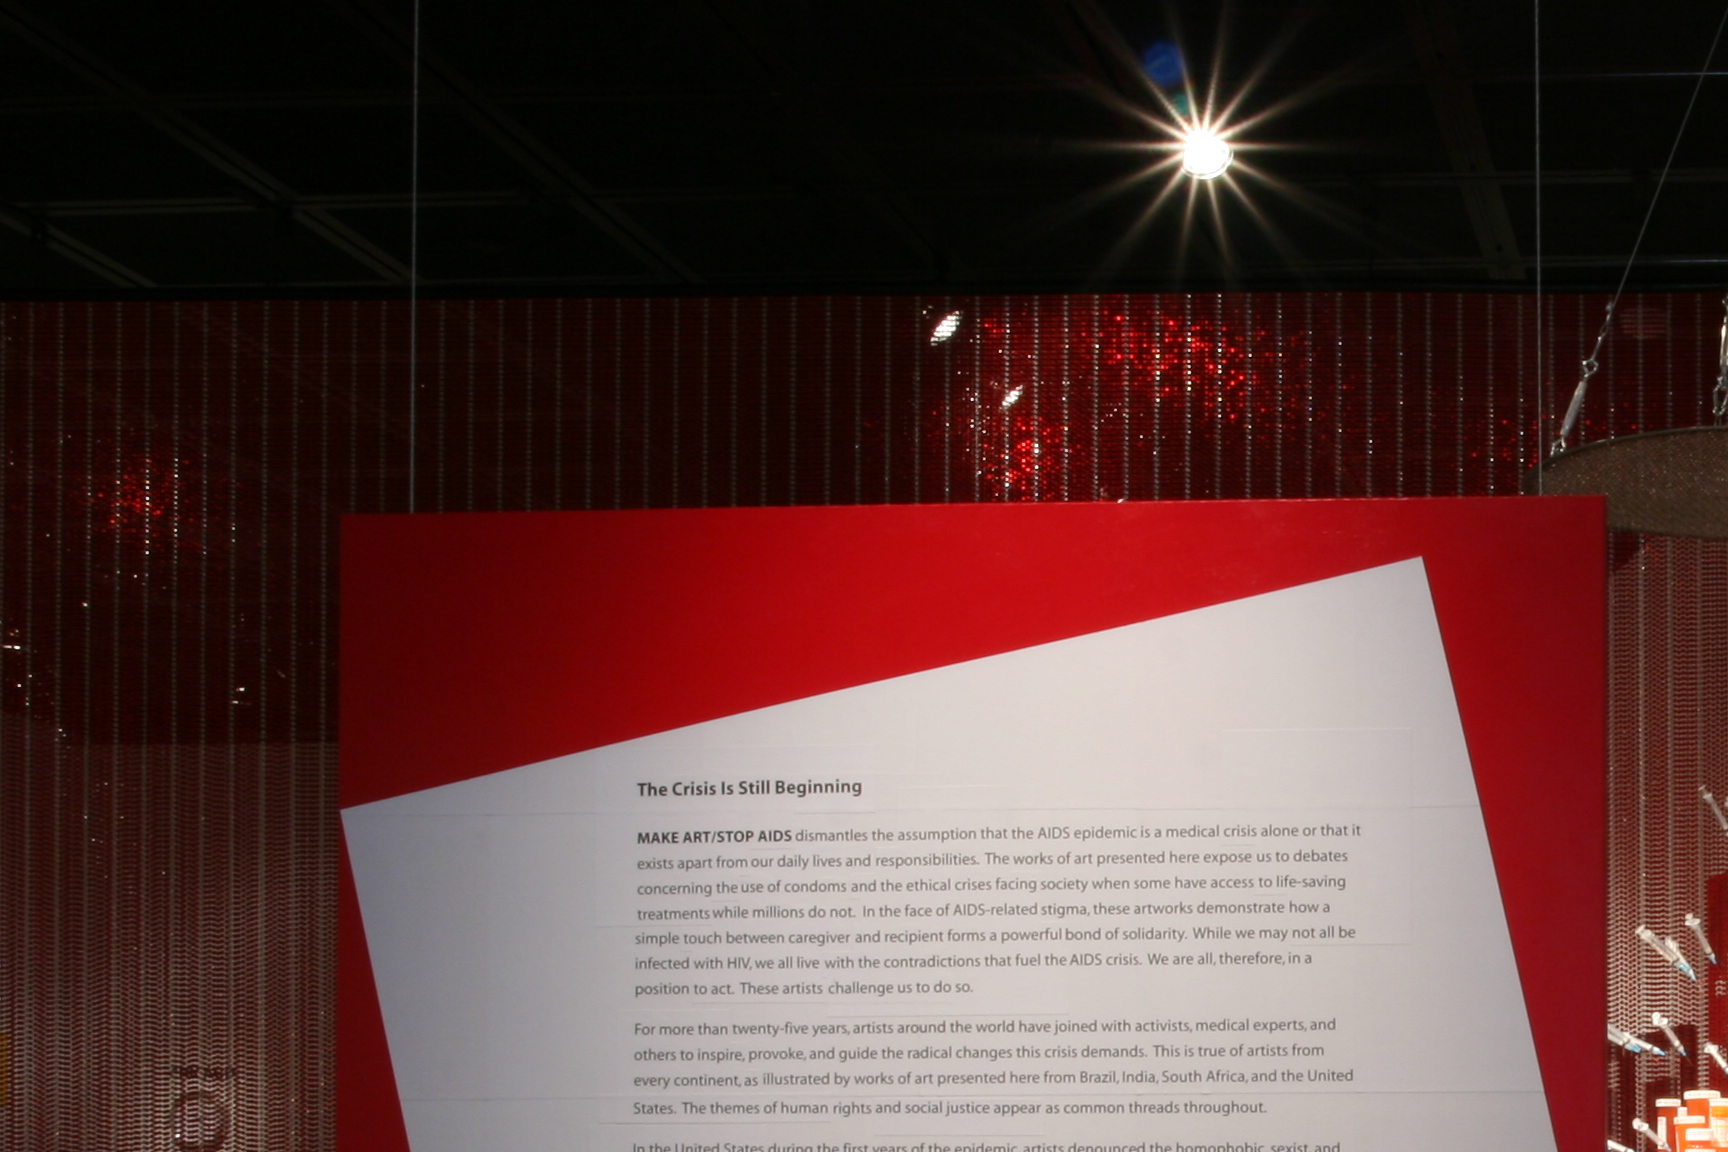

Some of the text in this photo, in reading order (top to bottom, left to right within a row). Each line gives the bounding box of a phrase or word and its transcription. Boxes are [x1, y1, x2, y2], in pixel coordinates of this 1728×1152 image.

[636, 778, 863, 799] The Crisis Is Still Beginning
[637, 823, 1361, 845] MAKE ART/STOP AIDS dismantles the assumption that the AIDS epidemic is a medical crisis alone or that it
[635, 925, 1356, 948] simple touch between caregiver and recipient forms a powerful bond of solidarity. While we may not all be
[634, 1017, 1336, 1038] For more than twenty-five years, artists around the world have joined with activists, medical experts, and
[633, 1068, 1354, 1090] every continent, as illustrated by works of art presented here from Brazil, India, South Africa, and the United
